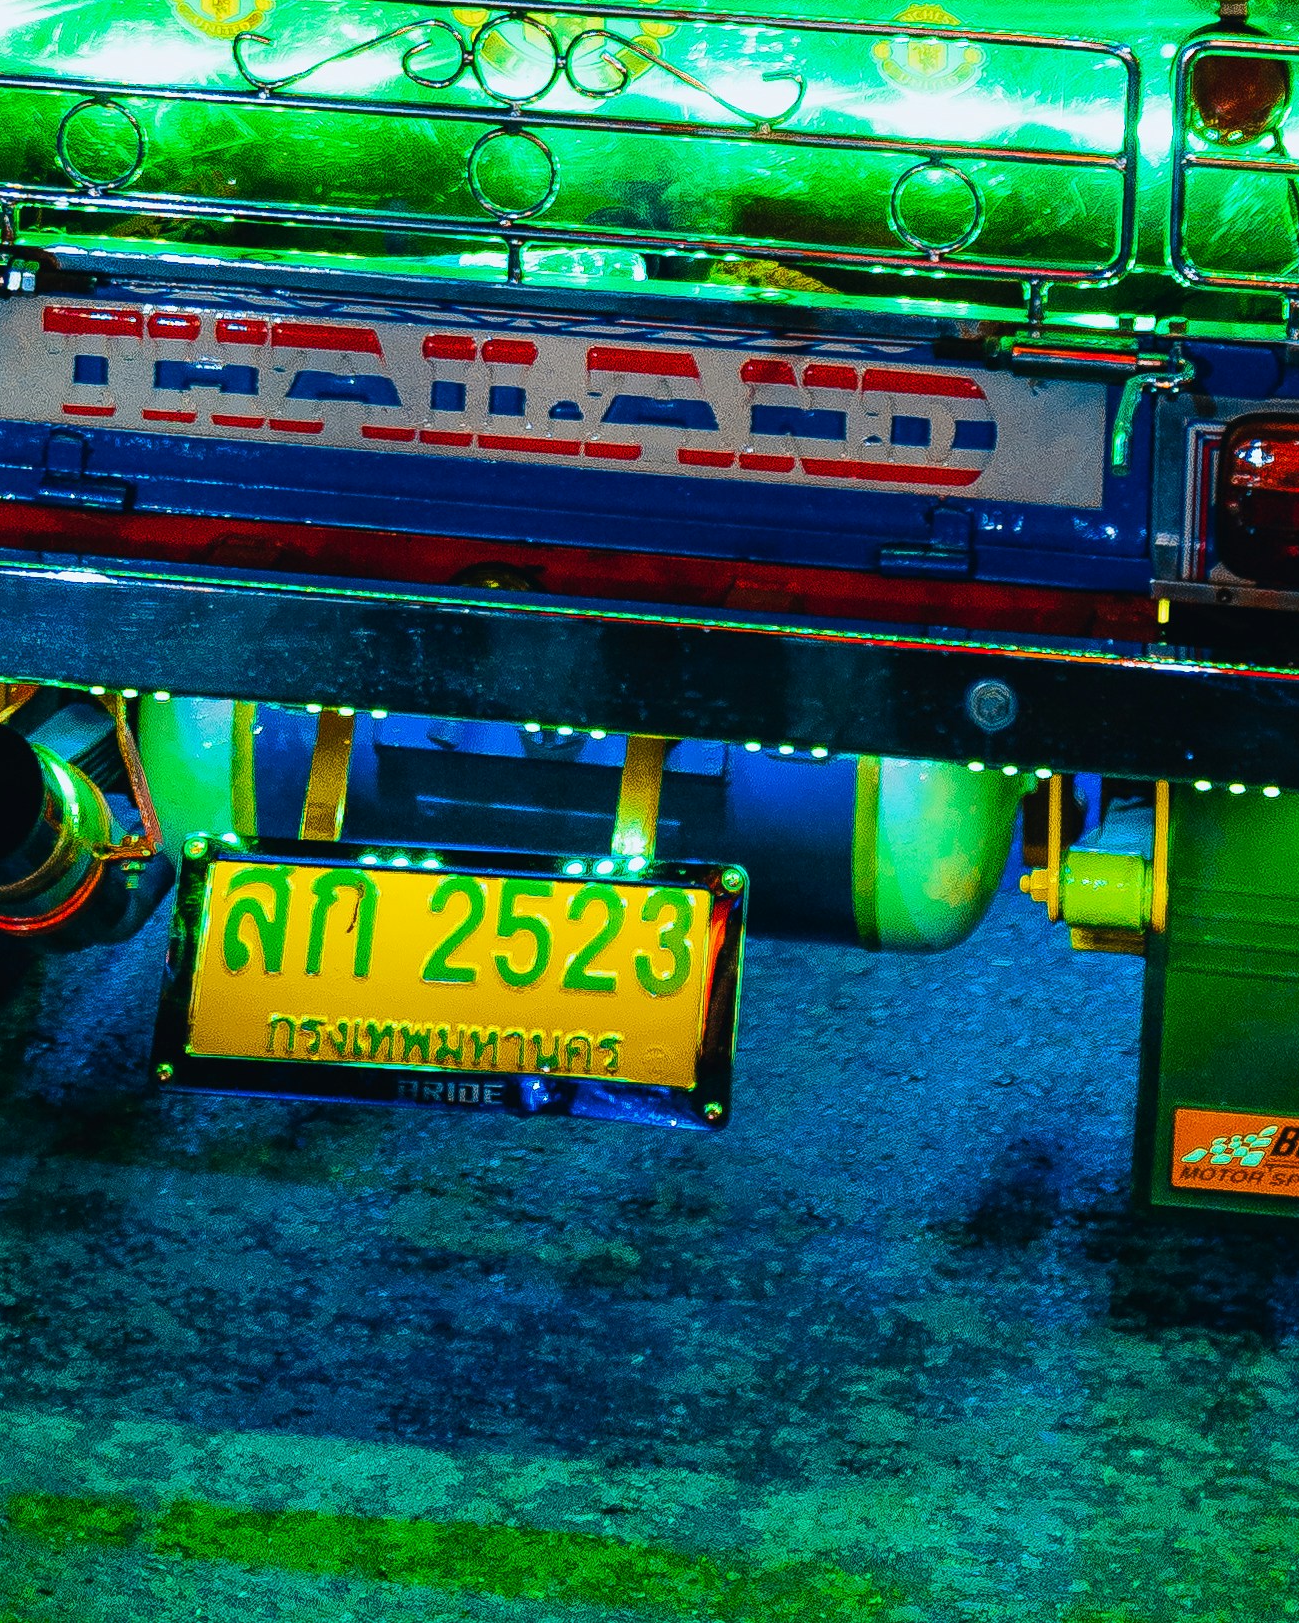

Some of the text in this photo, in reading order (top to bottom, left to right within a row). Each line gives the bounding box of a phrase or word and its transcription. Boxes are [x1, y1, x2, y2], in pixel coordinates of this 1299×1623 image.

[43, 304, 996, 487] THAILAND
[224, 864, 696, 998] สก 2523
[267, 1014, 624, 1073] กรงเทพมหานคร
[1179, 1164, 1266, 1186] MOTOR
